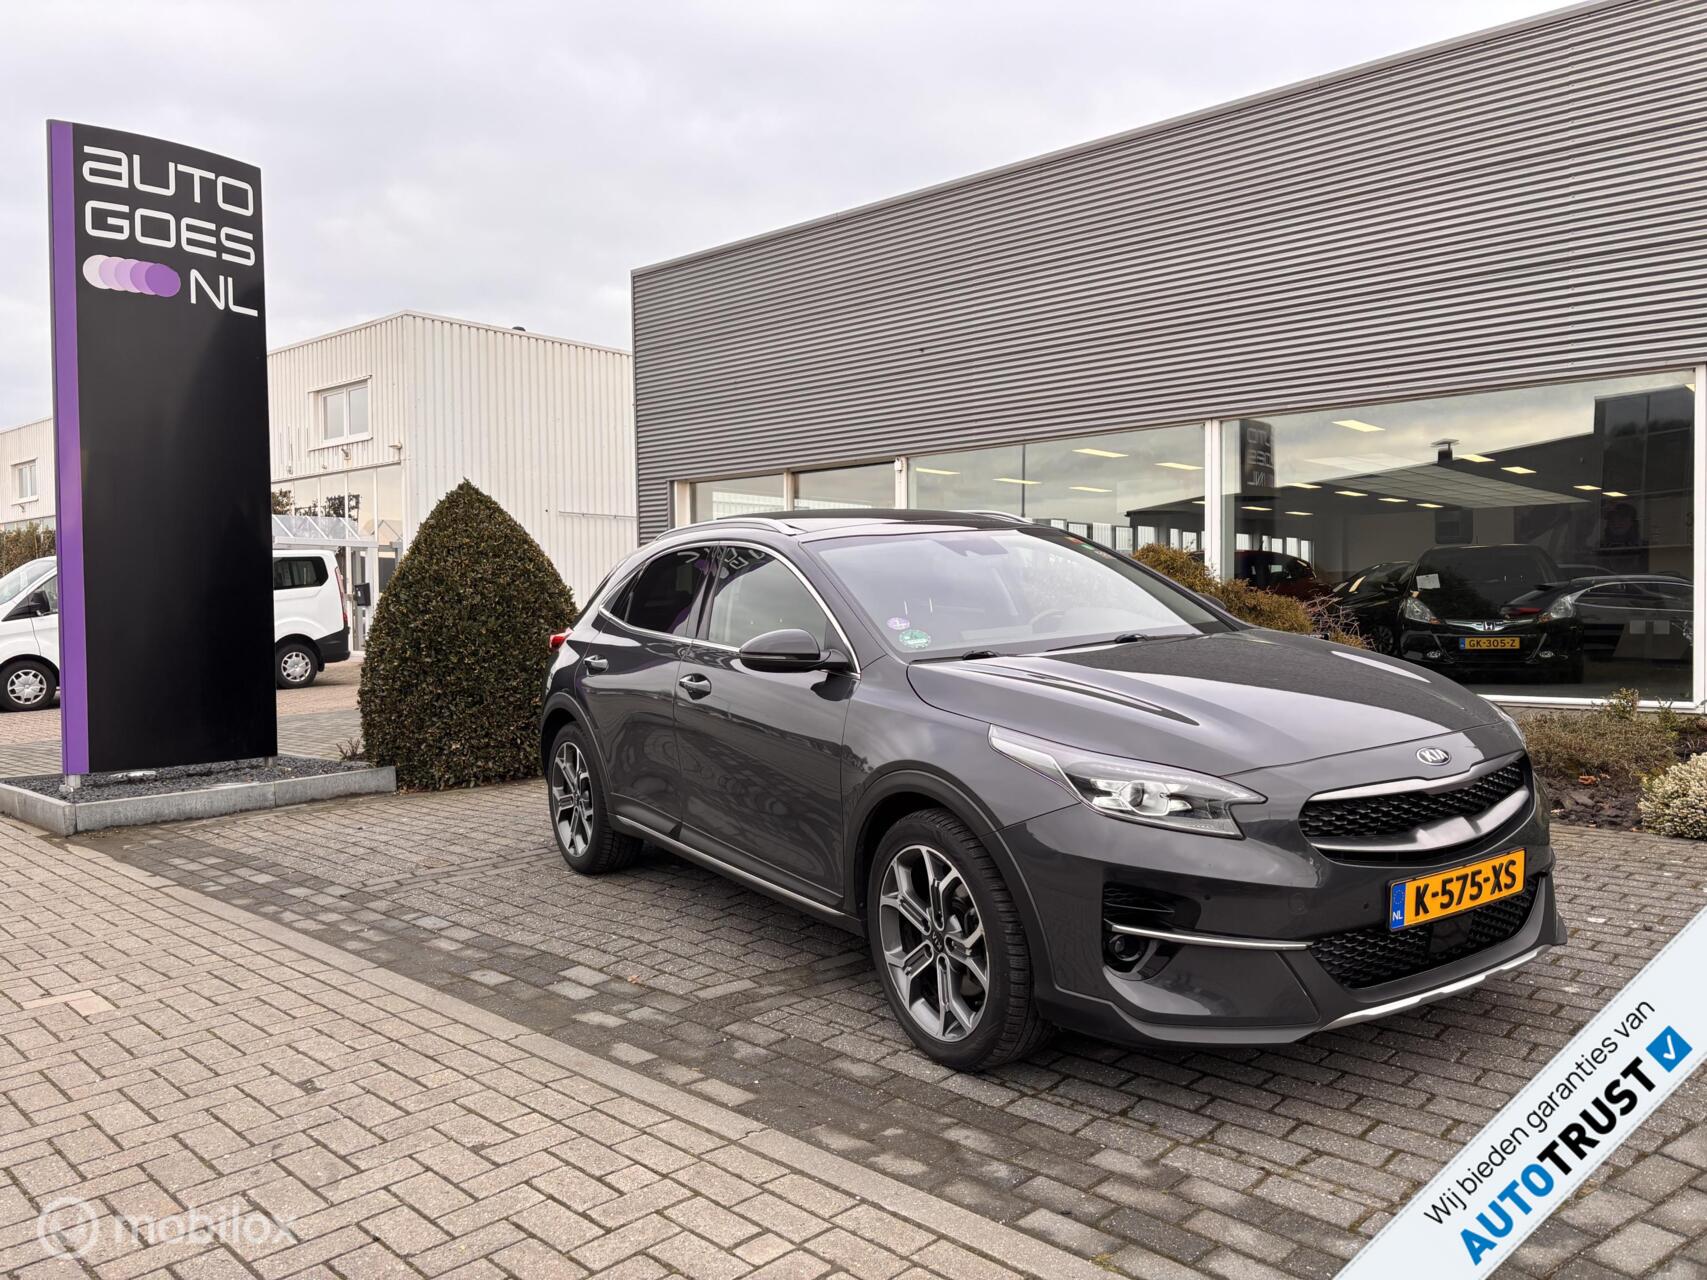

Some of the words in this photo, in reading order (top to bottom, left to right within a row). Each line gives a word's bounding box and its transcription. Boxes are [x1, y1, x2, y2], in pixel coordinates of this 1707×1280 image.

[84, 200, 256, 266] GOES
[189, 268, 259, 317] NL
[1468, 639, 1517, 648] GK-305-Z
[1414, 859, 1517, 917] K-575-XS
[1392, 910, 1403, 921] NL
